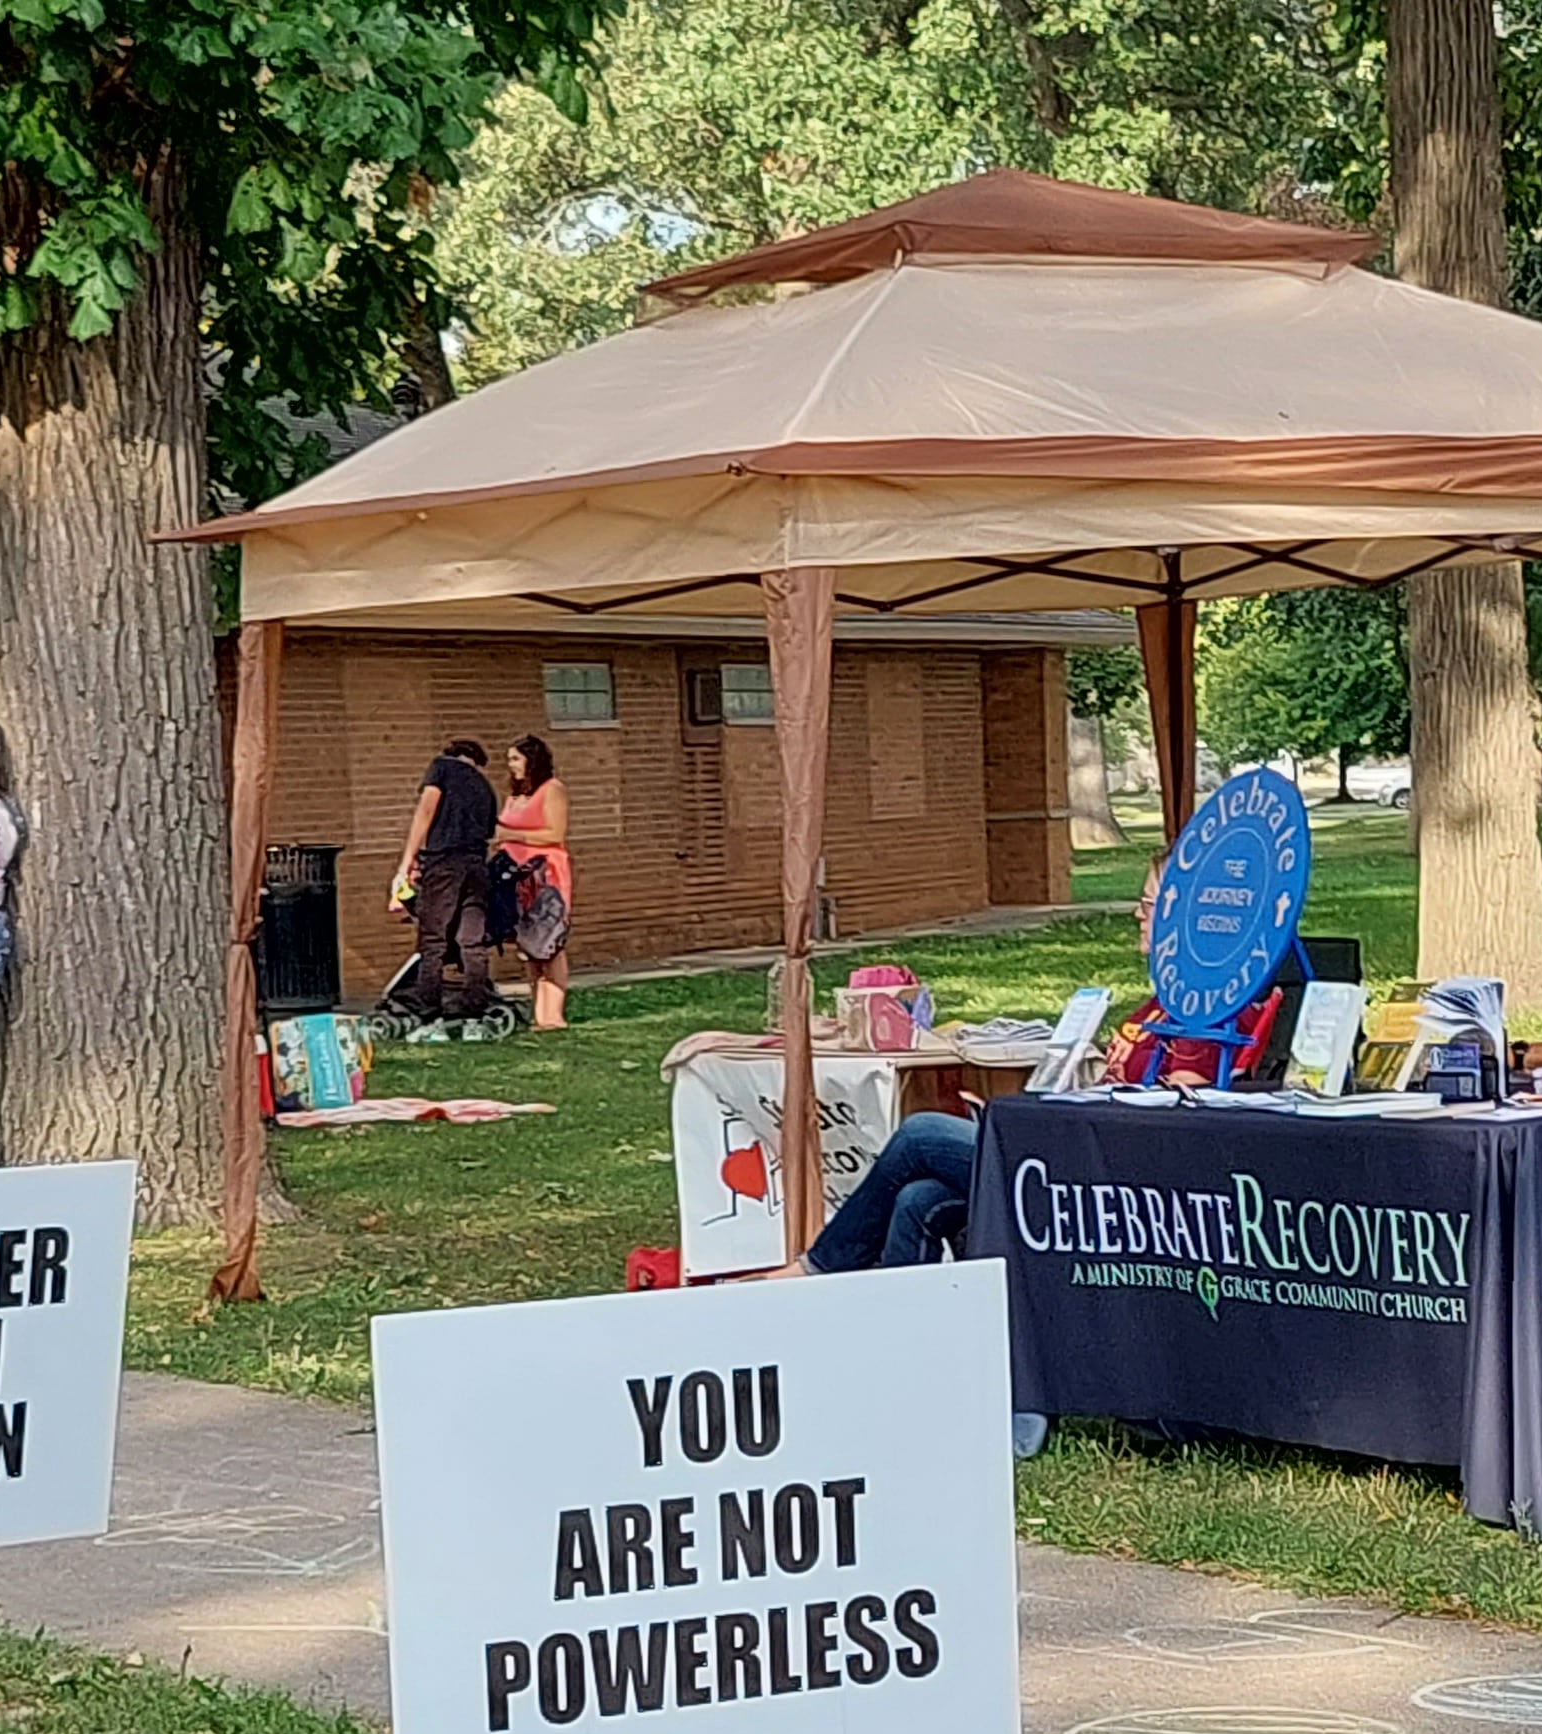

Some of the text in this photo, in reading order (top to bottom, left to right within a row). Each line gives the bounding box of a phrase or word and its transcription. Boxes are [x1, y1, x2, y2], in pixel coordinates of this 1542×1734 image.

[1177, 775, 1296, 873] Celebrate
[1155, 928, 1270, 1017] Recovery
[1221, 1275, 1272, 1304] GRACE
[1275, 1280, 1379, 1316] COMMUNITY
[1379, 1292, 1468, 1324] CHURCH
[625, 1364, 781, 1468] YOU
[554, 1477, 866, 1601] ARE NOT
[485, 1588, 941, 1732] POWERLESS
